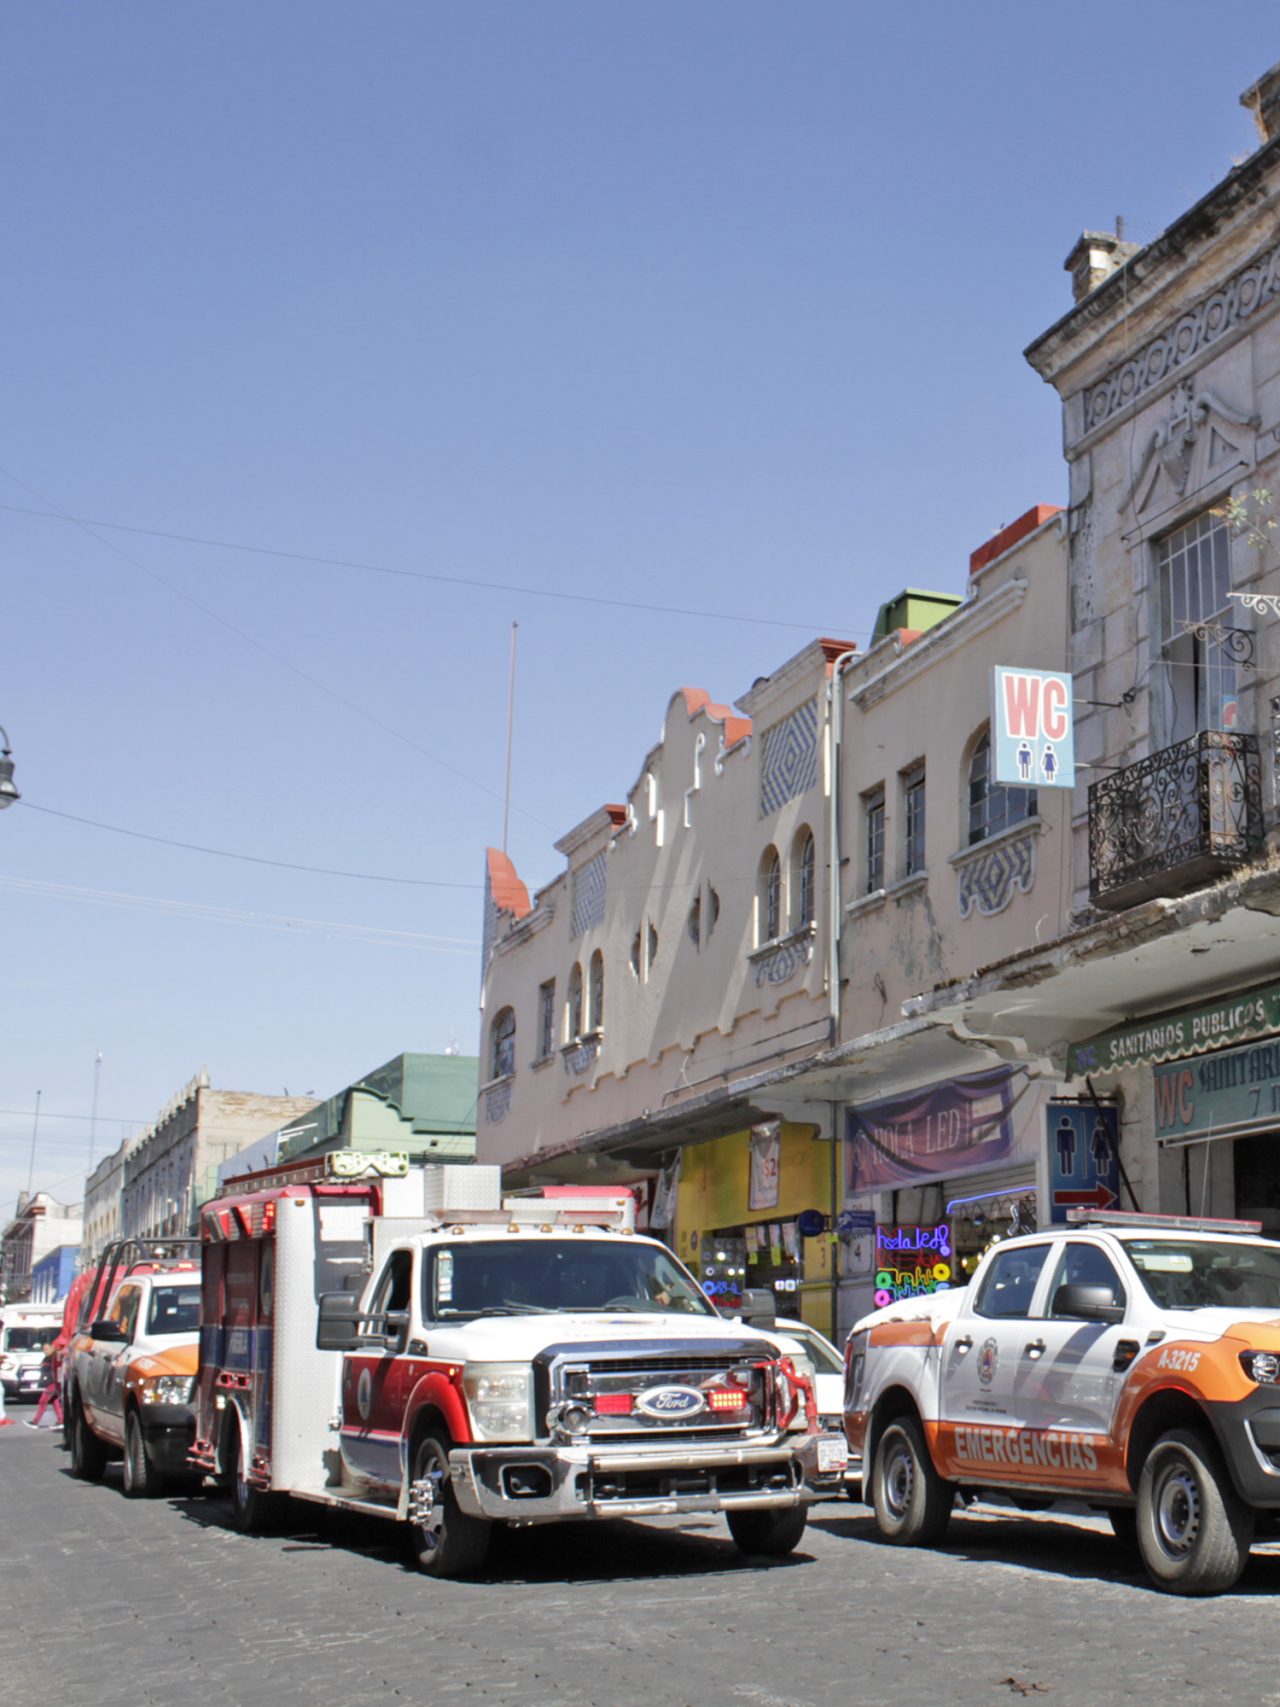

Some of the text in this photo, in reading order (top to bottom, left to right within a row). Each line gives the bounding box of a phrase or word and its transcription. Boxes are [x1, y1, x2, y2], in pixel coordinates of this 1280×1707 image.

[1003, 673, 1067, 741] WC
[1110, 1022, 1184, 1060] SANITARIOS
[1193, 999, 1265, 1039] PUBLICOS
[1154, 1068, 1194, 1130] WC
[1249, 1085, 1262, 1117] 7
[926, 1109, 960, 1153] LED
[1157, 1348, 1201, 1373] A-3215
[655, 1391, 690, 1411] Ford
[954, 1426, 1099, 1472] EMERGENCIAS
